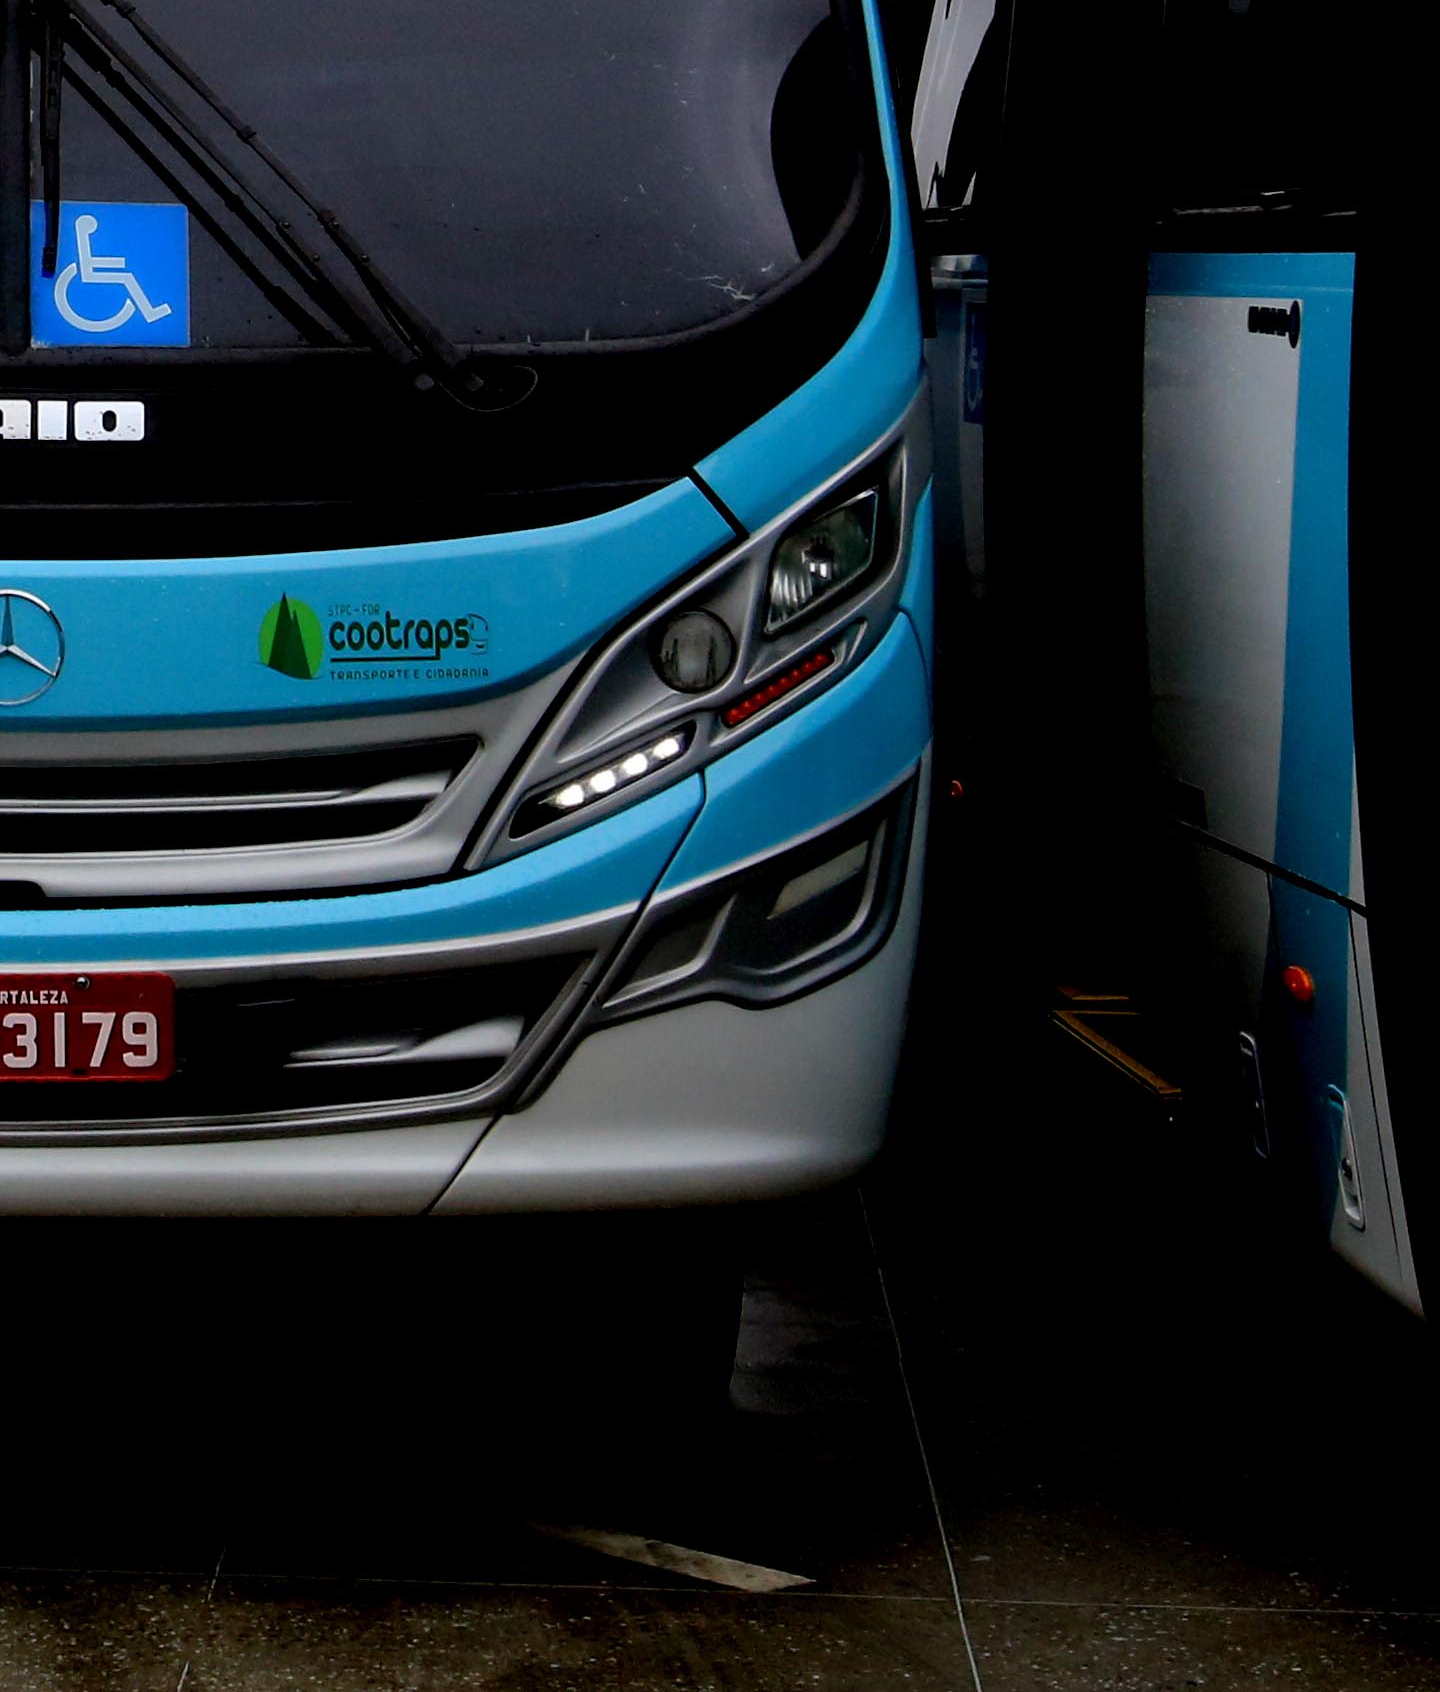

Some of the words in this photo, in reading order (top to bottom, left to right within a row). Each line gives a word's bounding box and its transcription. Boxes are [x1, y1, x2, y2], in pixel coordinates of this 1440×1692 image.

[329, 611, 470, 659] cootraps
[330, 669, 408, 680] TRANSPORTE
[426, 667, 489, 679] CIDADANIA
